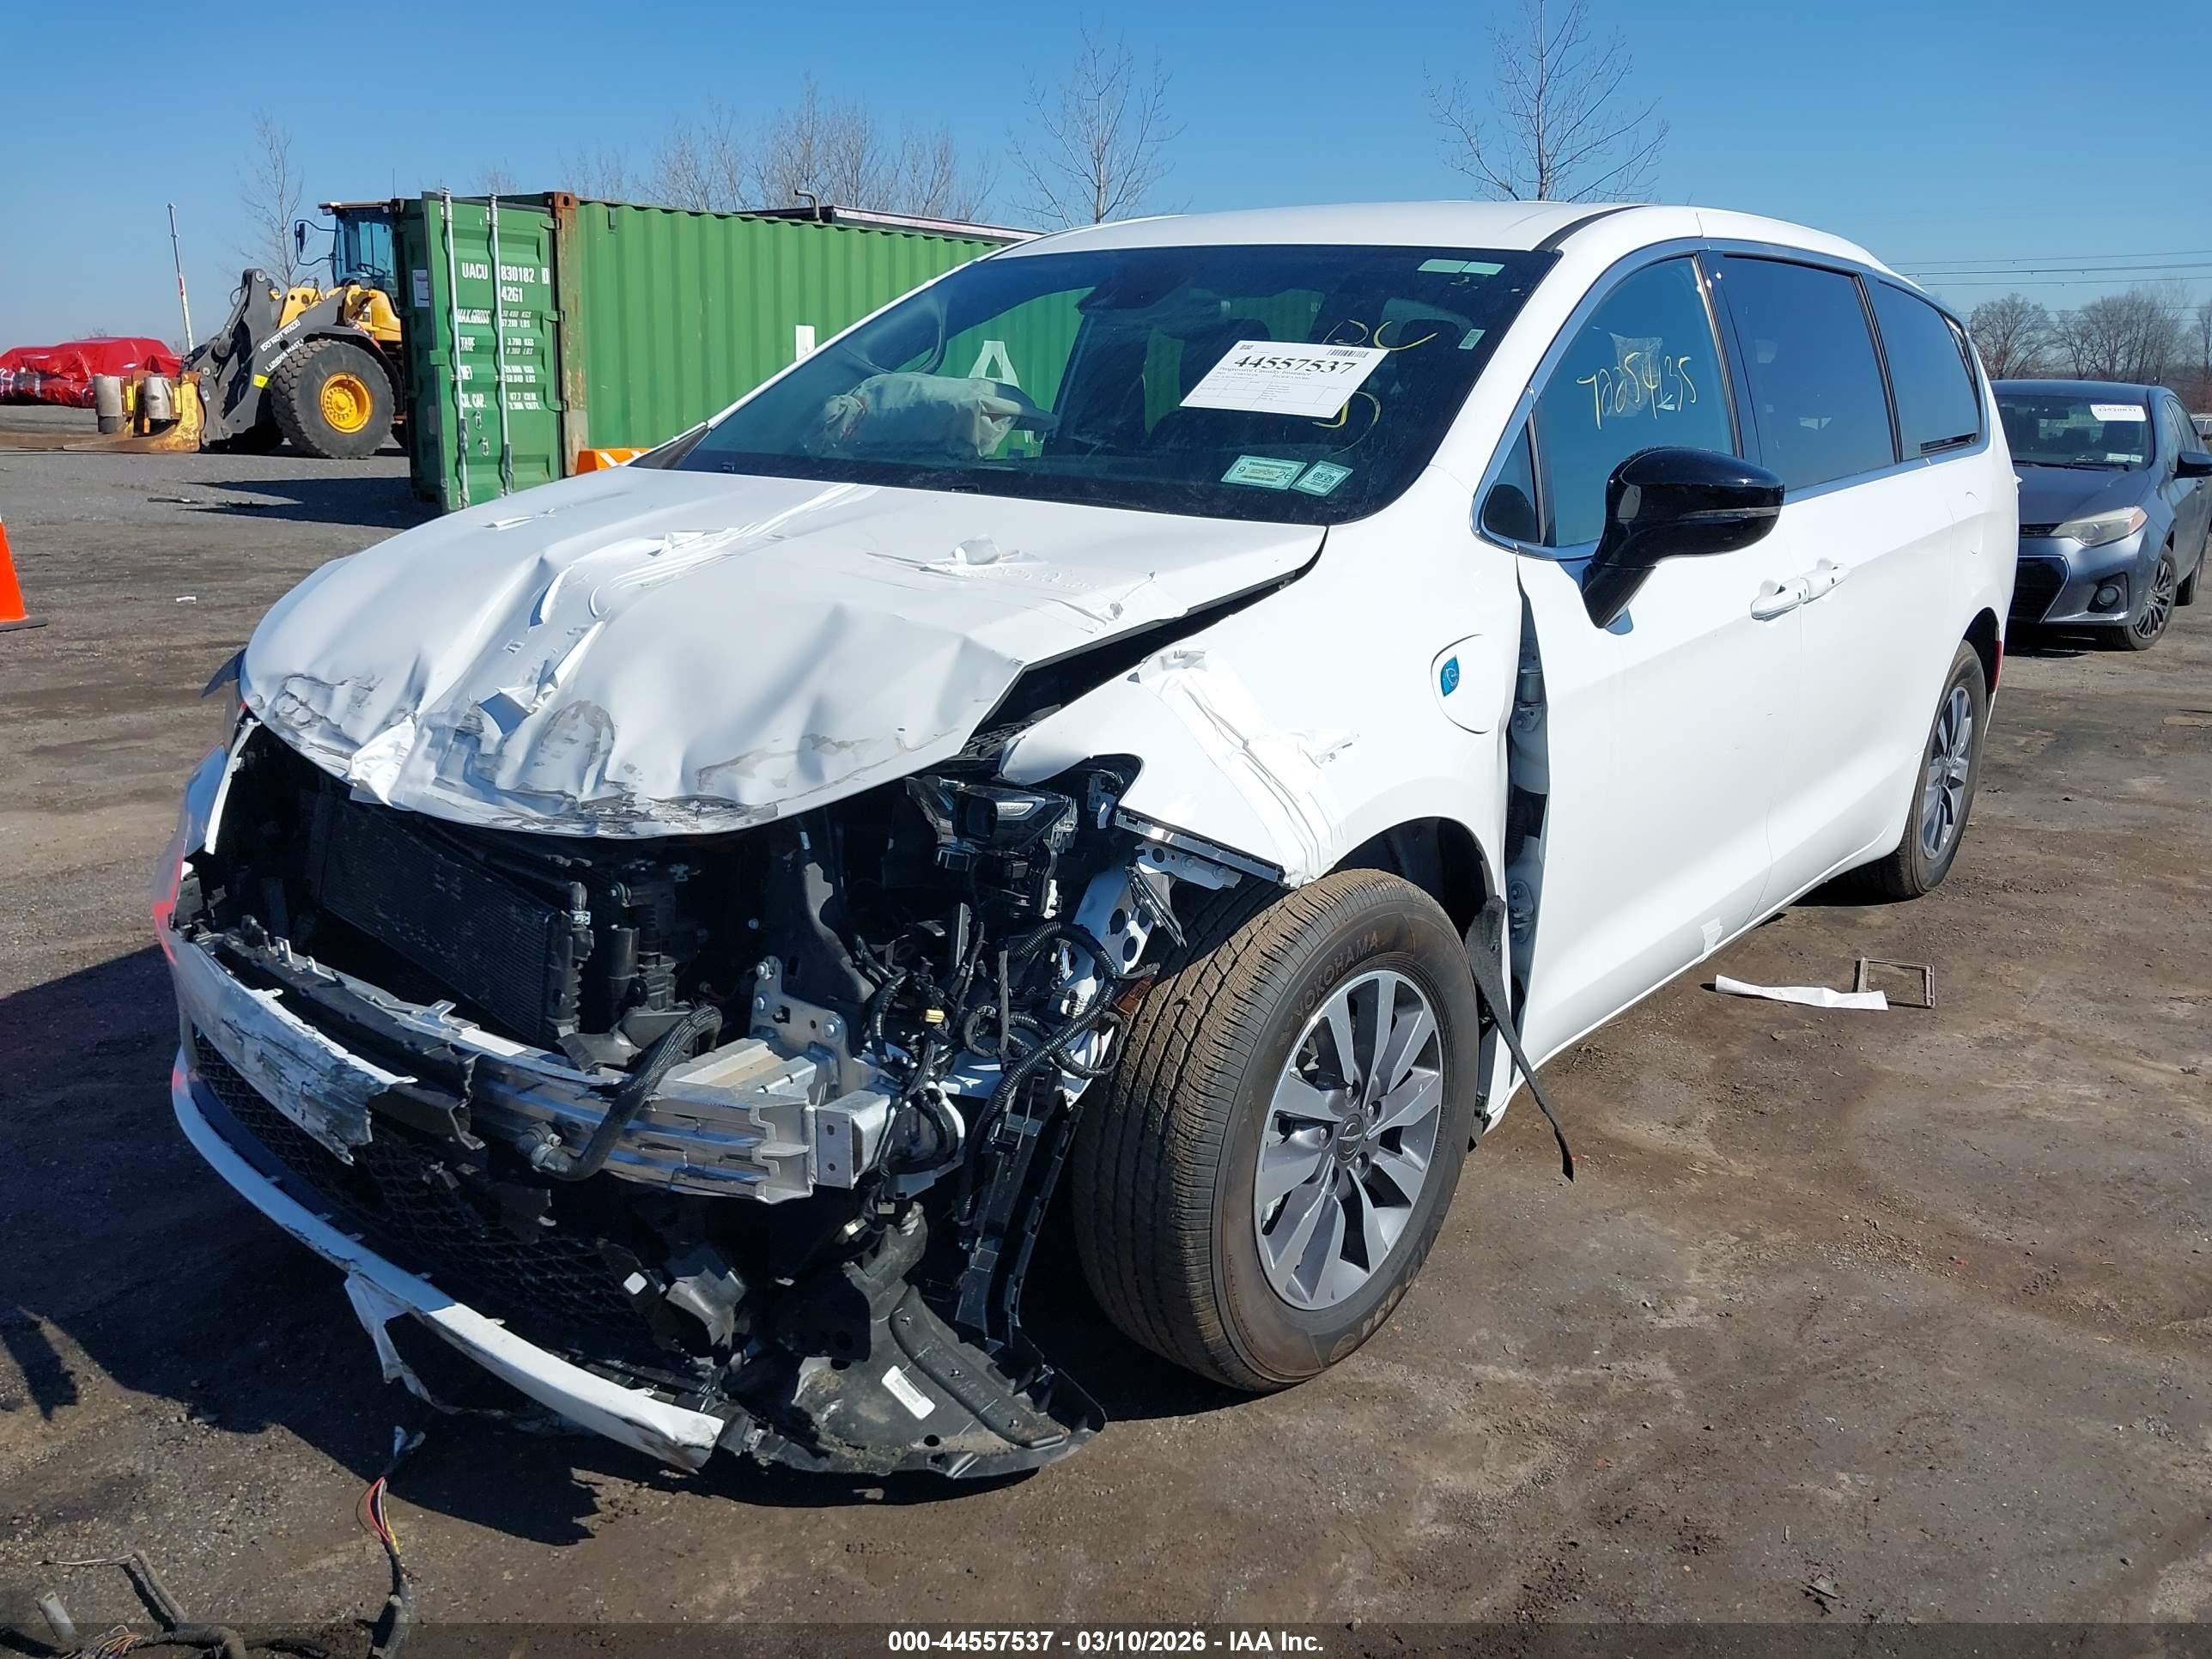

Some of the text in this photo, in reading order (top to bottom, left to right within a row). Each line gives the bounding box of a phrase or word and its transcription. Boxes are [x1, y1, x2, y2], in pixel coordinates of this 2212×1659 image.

[461, 262, 488, 280] UACU
[501, 264, 535, 283] 830182
[501, 286, 523, 303] 42G1
[520, 319, 531, 328] LBS
[260, 341, 271, 352] DO
[270, 332, 283, 345] NOT
[459, 337, 475, 352] TARE
[524, 338, 535, 347] KGS
[1233, 355, 1358, 375] 44557537
[526, 374, 536, 383] LBS
[1293, 930, 1378, 1020] YOKOHAMA
